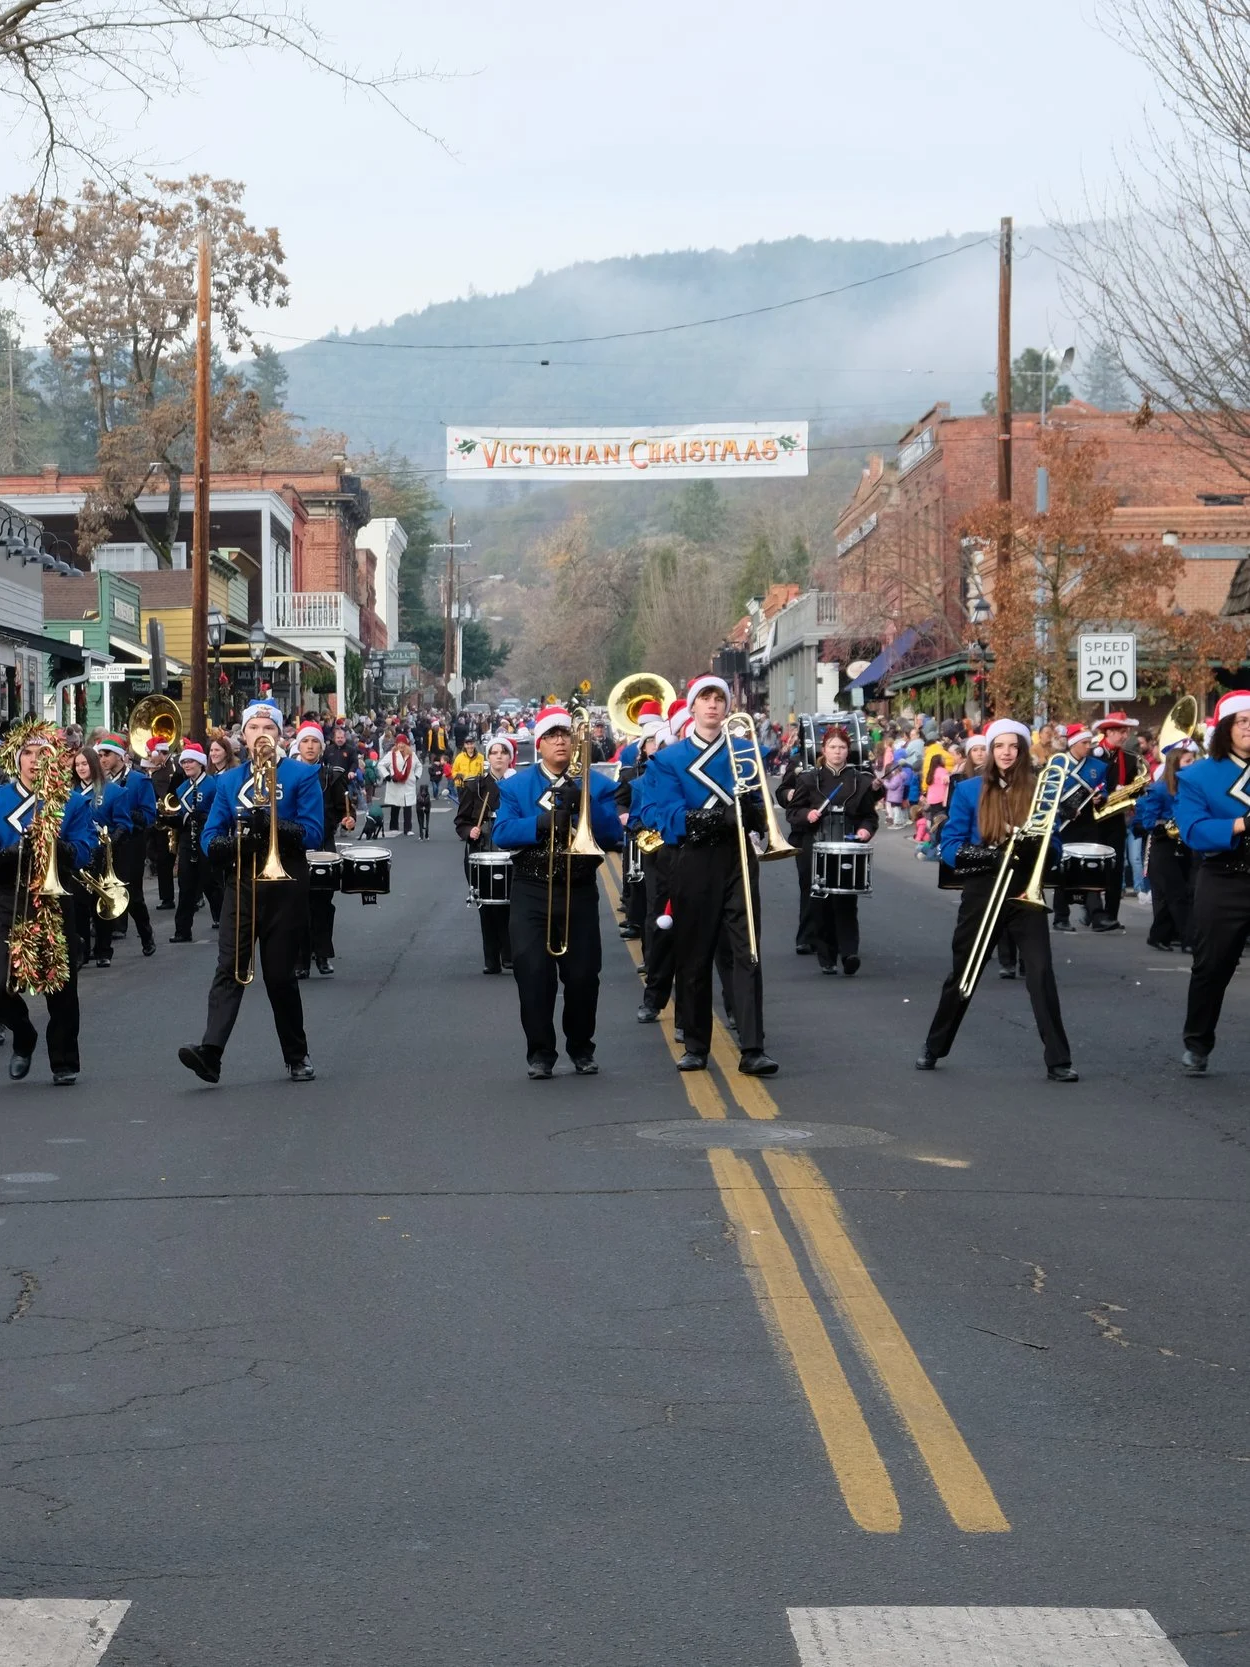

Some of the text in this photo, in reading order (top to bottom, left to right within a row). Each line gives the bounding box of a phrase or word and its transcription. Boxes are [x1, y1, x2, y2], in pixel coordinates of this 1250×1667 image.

[481, 437, 779, 469] VICTORIAN CHRISTMAS
[1084, 641, 1130, 652] SPEED
[388, 651, 417, 660] VILLE
[1089, 655, 1125, 666] LIMIT
[1086, 669, 1128, 692] 20
